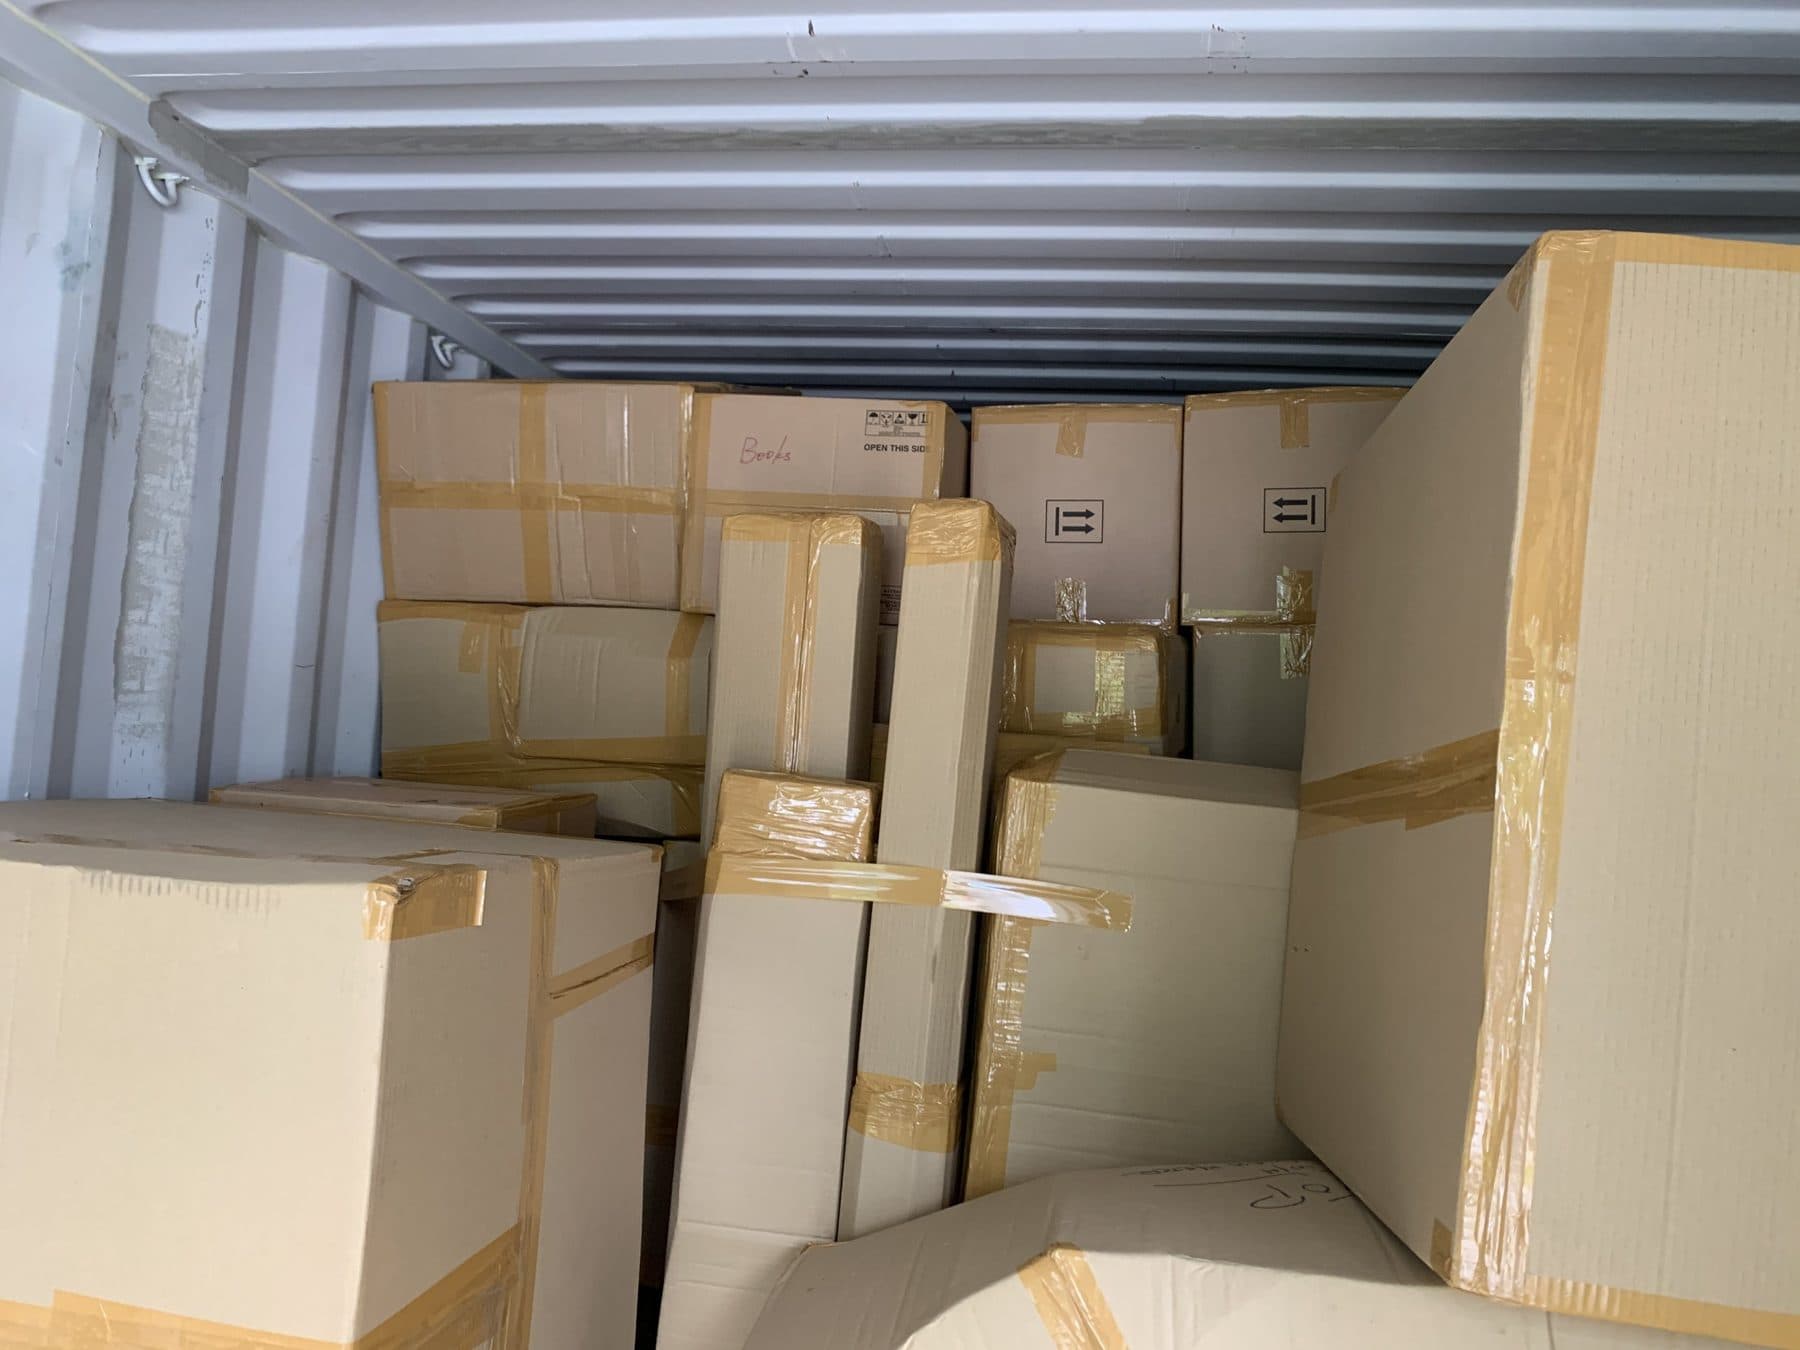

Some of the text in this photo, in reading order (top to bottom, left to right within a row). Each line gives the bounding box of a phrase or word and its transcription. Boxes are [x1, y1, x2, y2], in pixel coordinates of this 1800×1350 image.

[740, 435, 791, 464] Books
[864, 443, 888, 452] OPEN
[890, 444, 909, 453] THIS
